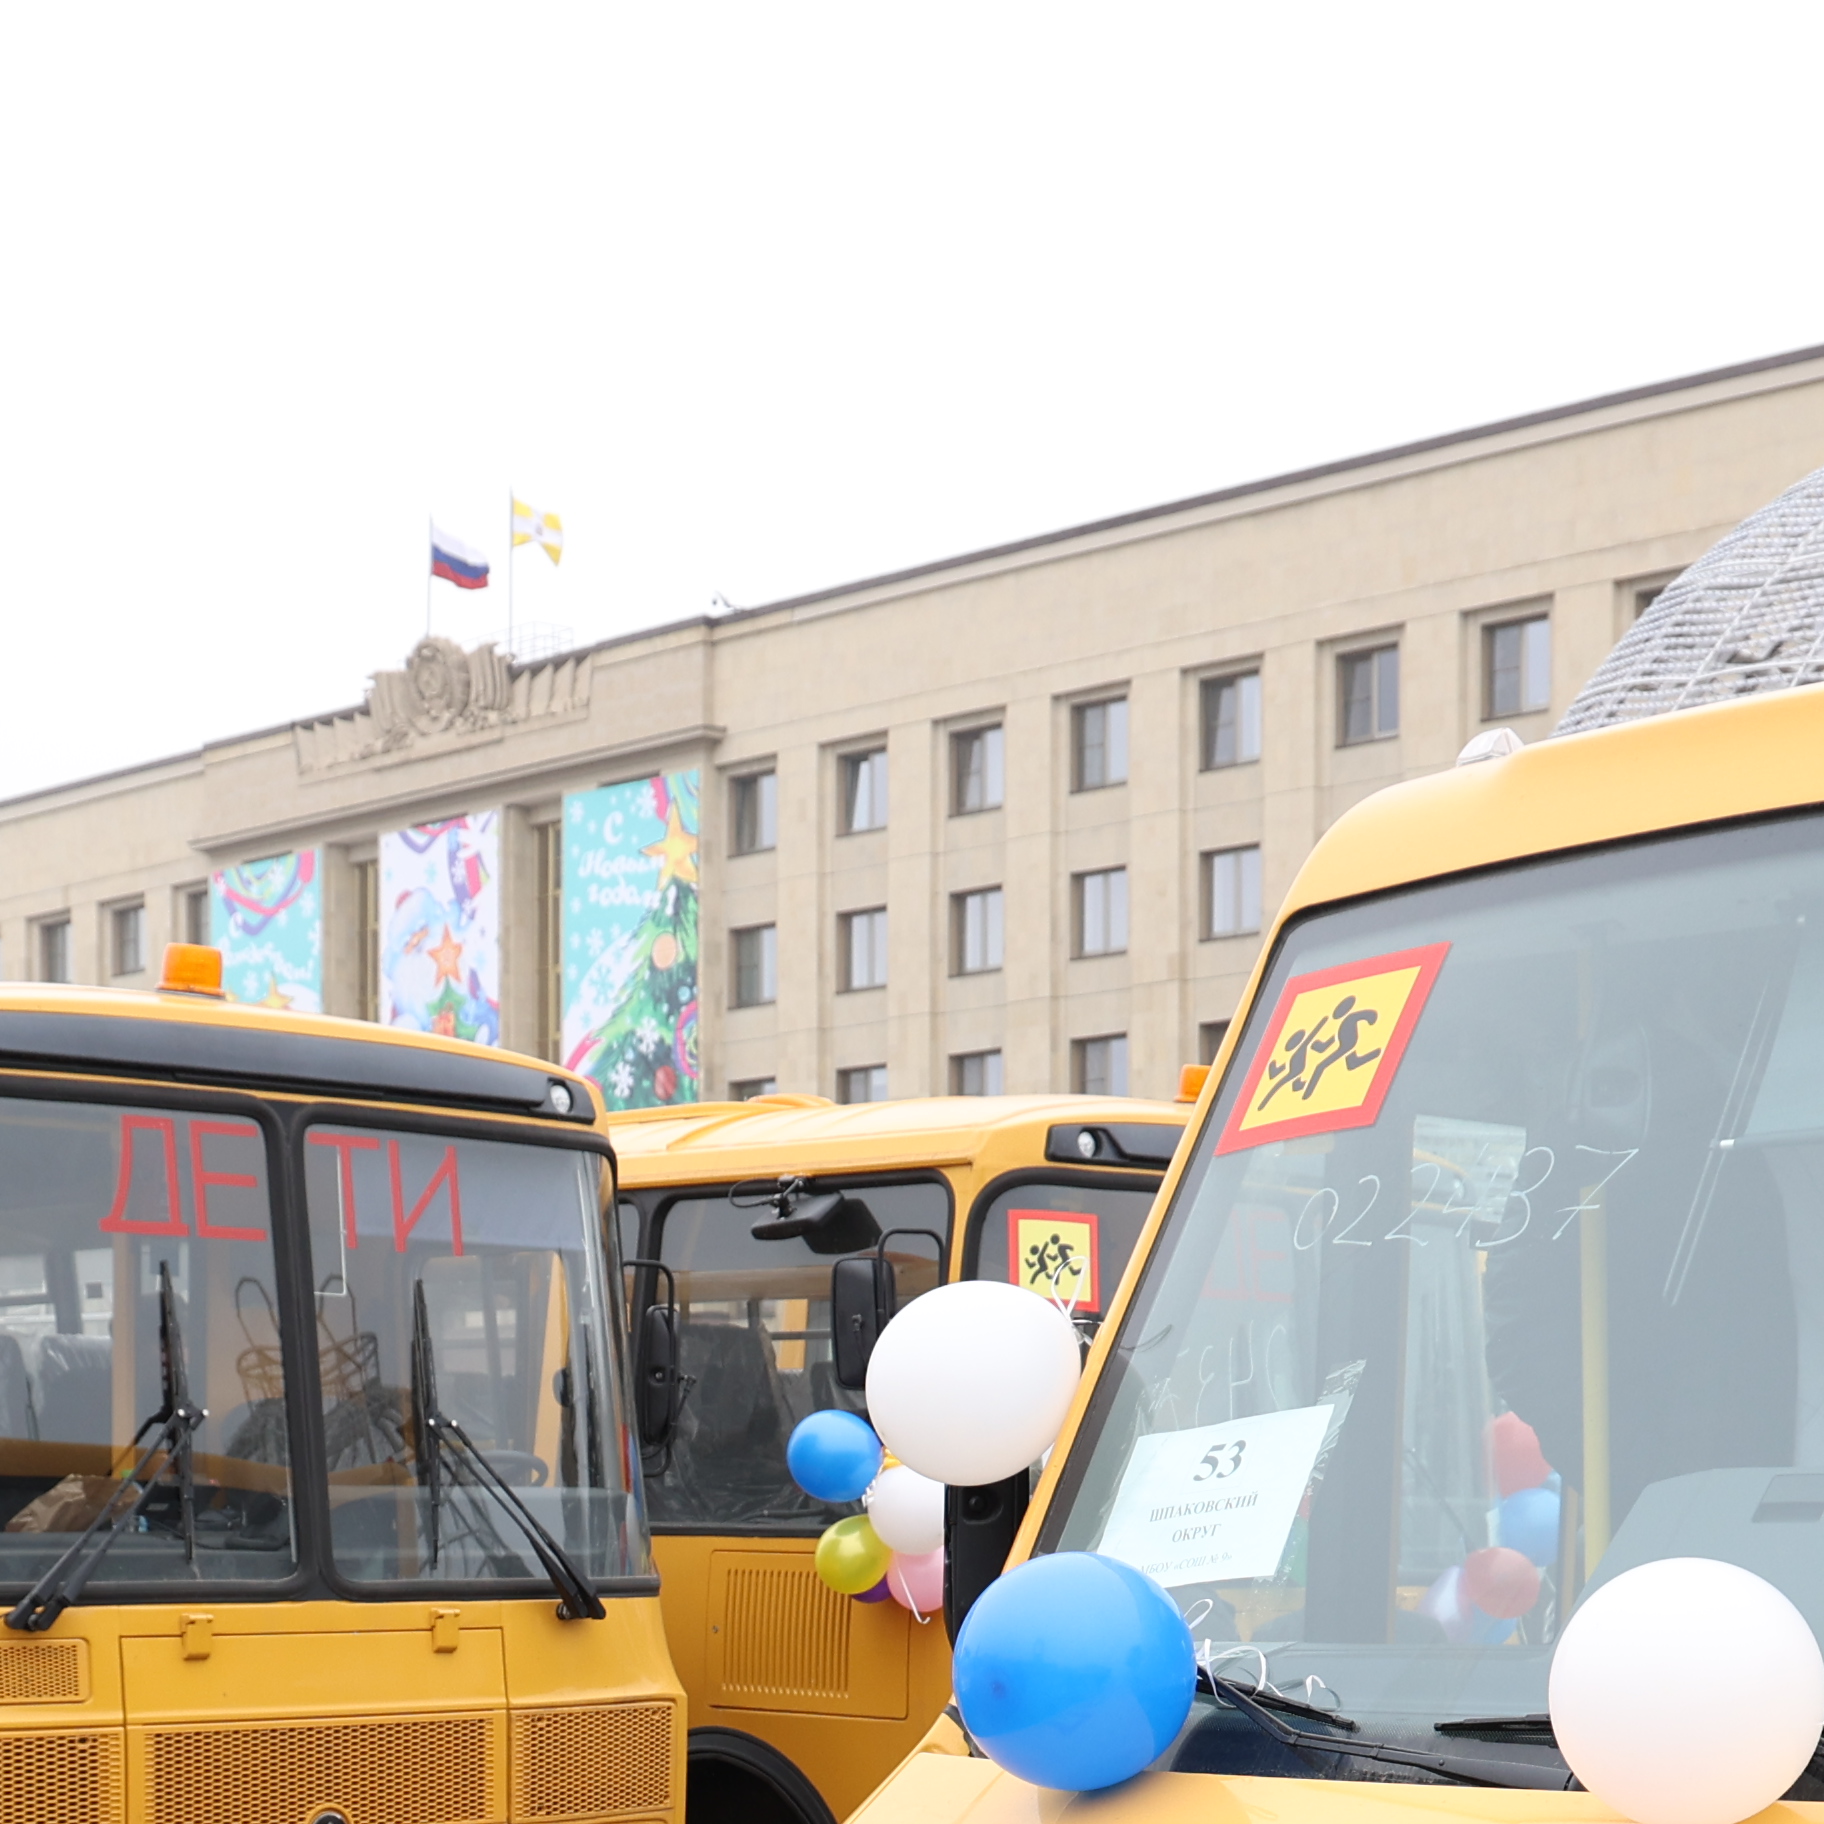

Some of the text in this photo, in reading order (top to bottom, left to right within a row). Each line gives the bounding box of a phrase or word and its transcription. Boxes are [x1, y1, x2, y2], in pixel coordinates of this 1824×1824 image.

[99, 1114, 464, 1257] ДЕТИ
[1193, 1440, 1246, 1482] 53
[1149, 1491, 1259, 1523] ШПАКОВСКИЙ
[1172, 1523, 1222, 1543] ОКРУГ
